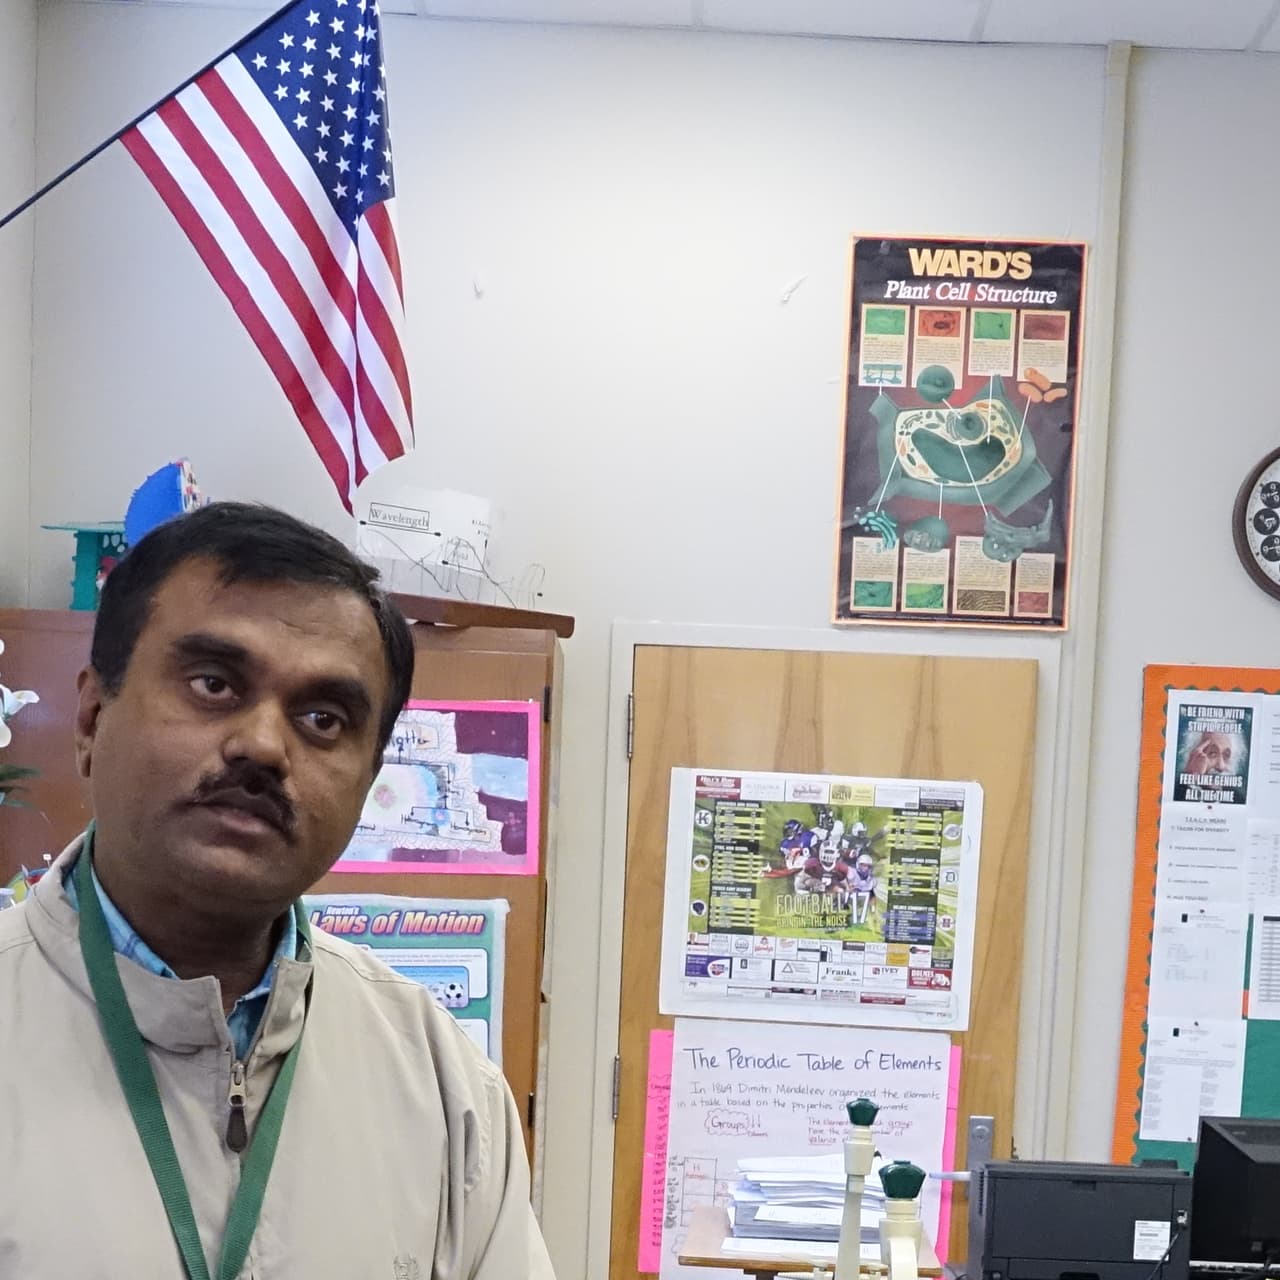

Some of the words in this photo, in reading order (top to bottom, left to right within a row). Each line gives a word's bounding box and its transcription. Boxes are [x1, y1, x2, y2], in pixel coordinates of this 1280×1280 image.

[908, 247, 1033, 281] WARD'S
[883, 280, 933, 300] Plant
[935, 282, 971, 301] Cell
[974, 283, 1058, 304] Structure
[370, 507, 430, 528] Wavelength
[1186, 706, 1197, 718] BE
[1225, 708, 1245, 720] WITH
[1187, 721, 1215, 732] STUPID
[1179, 773, 1197, 786] FEEL
[1197, 774, 1213, 786] LIKE
[1214, 775, 1243, 787] GENIUS
[1185, 788, 1200, 801] ALL
[326, 905, 360, 916] Newton's
[776, 893, 847, 916] FOOTBALL
[311, 911, 368, 935] Laws
[371, 911, 400, 935] of
[399, 910, 486, 935] Motion
[682, 1048, 720, 1070] The
[726, 1047, 791, 1070] Periodic
[796, 1053, 845, 1071] Table
[854, 1049, 874, 1071] of
[879, 1053, 942, 1071] Elements
[690, 1081, 706, 1094] In
[882, 1088, 900, 1100] the
[711, 1115, 746, 1133] Groups
